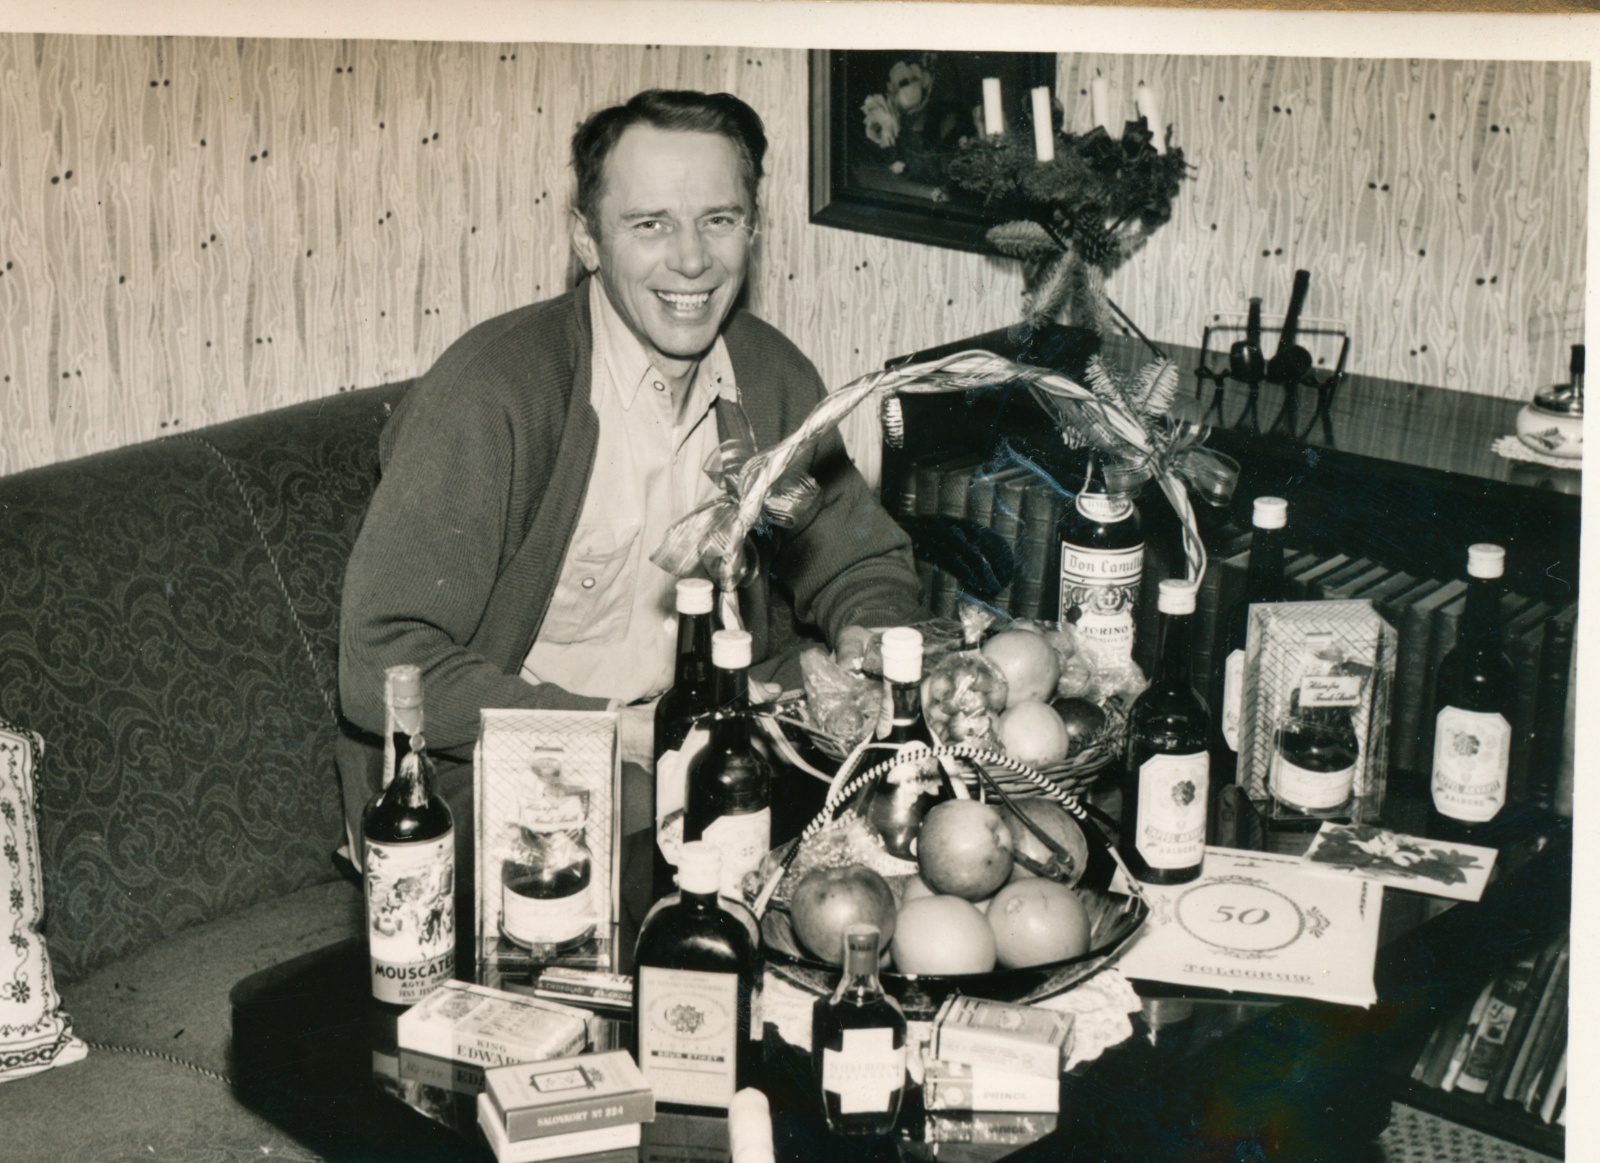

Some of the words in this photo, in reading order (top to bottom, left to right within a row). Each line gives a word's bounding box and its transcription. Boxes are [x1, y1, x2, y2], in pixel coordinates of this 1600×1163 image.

[1069, 554, 1095, 573] Don
[1083, 625, 1129, 635] TORINO
[1208, 905, 1270, 925] 50
[457, 1045, 526, 1065] EDWAR
[477, 1039, 507, 1053] KING
